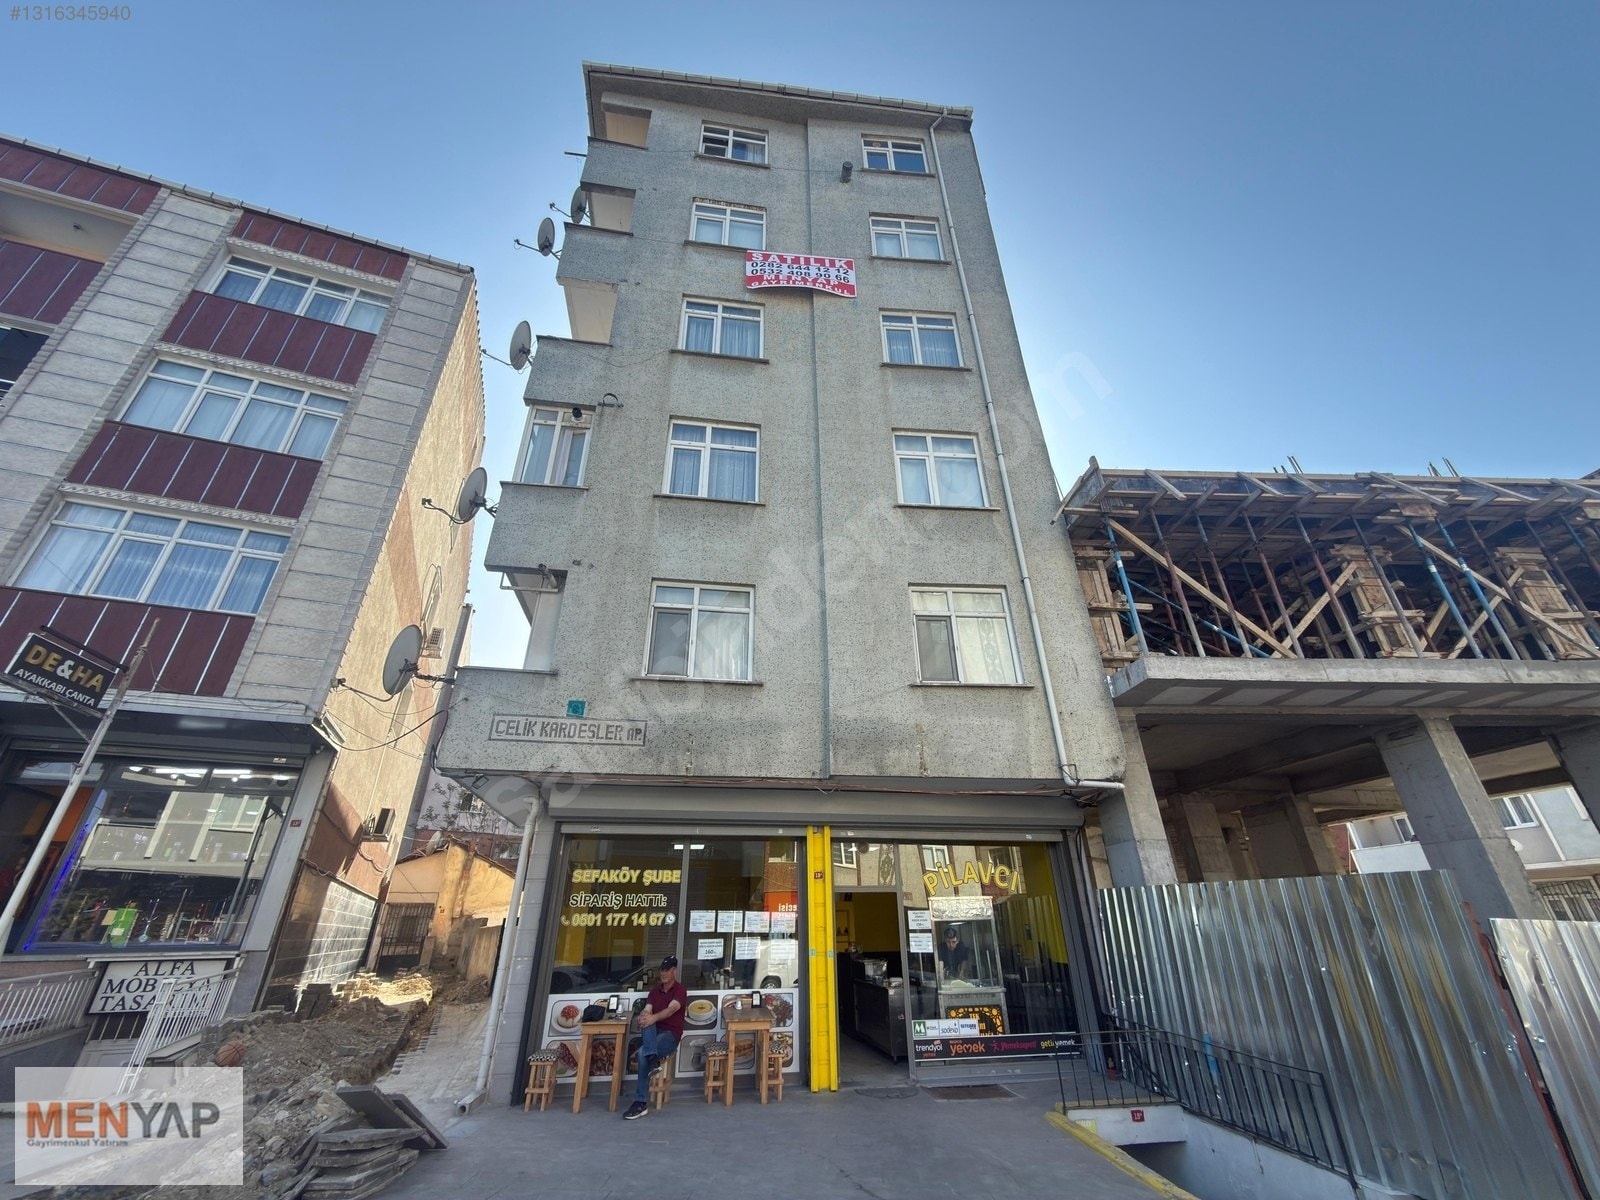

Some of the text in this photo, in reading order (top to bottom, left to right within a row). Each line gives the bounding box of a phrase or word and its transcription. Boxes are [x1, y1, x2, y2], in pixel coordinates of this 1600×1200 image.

[751, 252, 849, 269] SATILIK
[751, 261, 783, 269] 0282
[815, 265, 831, 273] 12
[834, 268, 849, 276] 12
[763, 274, 839, 286] MENYAP
[25, 644, 105, 693] DE&HA
[14, 668, 96, 707] AYAKKABI ÇANTA
[572, 866, 682, 886] SEFAKÖY ŞUBE
[922, 861, 1019, 896] PİLAVCI
[569, 891, 623, 910] SİPARİŞ
[571, 912, 666, 926] 0501 177 14 67
[134, 961, 195, 977] ALFA
[102, 977, 211, 994] MOBYA
[915, 1044, 943, 1052] trendyol
[949, 1041, 985, 1056] yemek
